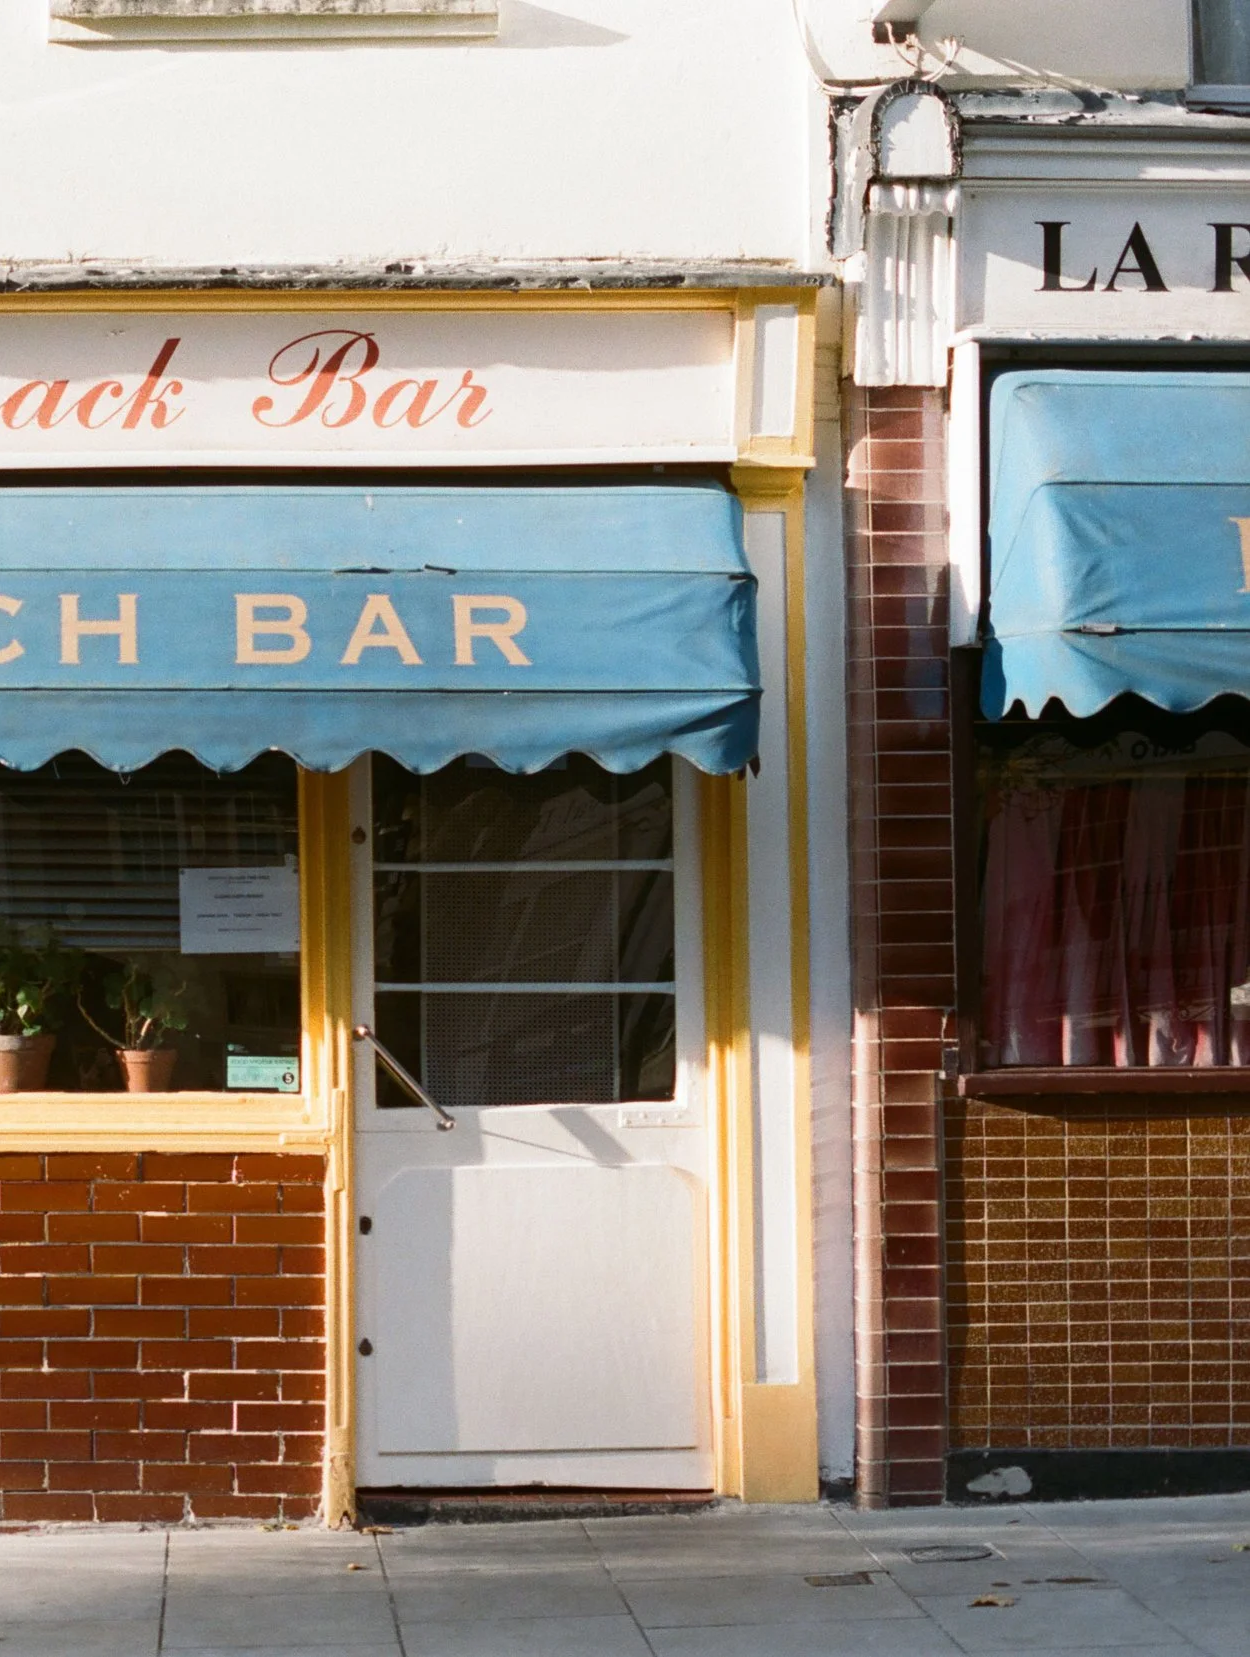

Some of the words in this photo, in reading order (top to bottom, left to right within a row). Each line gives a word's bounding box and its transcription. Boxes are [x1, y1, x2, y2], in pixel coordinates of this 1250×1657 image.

[1034, 220, 1171, 293] LA
[250, 329, 493, 428] Bar
[233, 593, 533, 666] BAR
